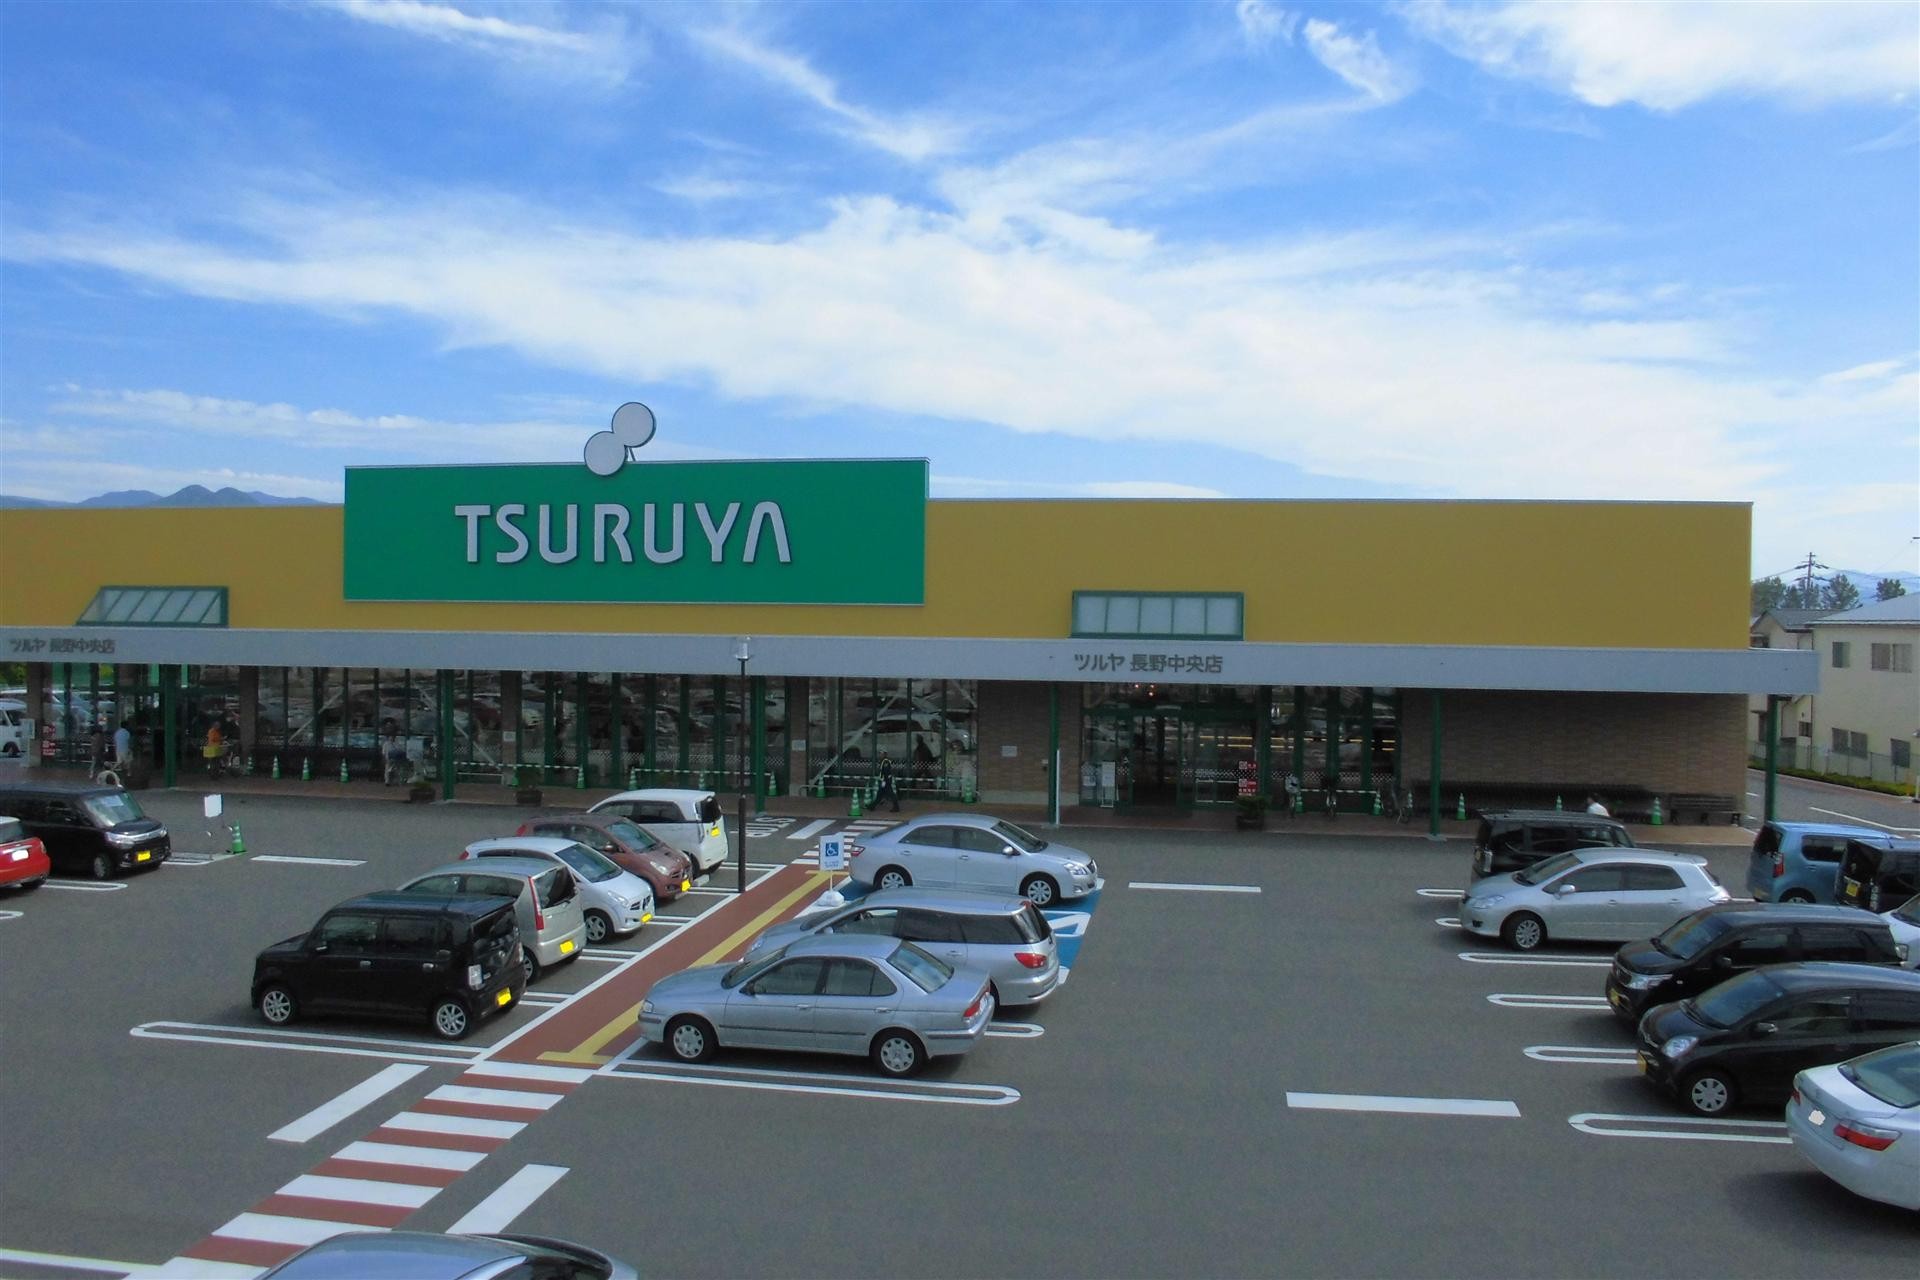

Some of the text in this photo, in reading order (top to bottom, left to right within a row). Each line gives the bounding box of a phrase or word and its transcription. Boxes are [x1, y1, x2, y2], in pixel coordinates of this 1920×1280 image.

[454, 501, 792, 564] TSURUYA
[1074, 653, 1223, 673] ツルヤ 長野中央店
